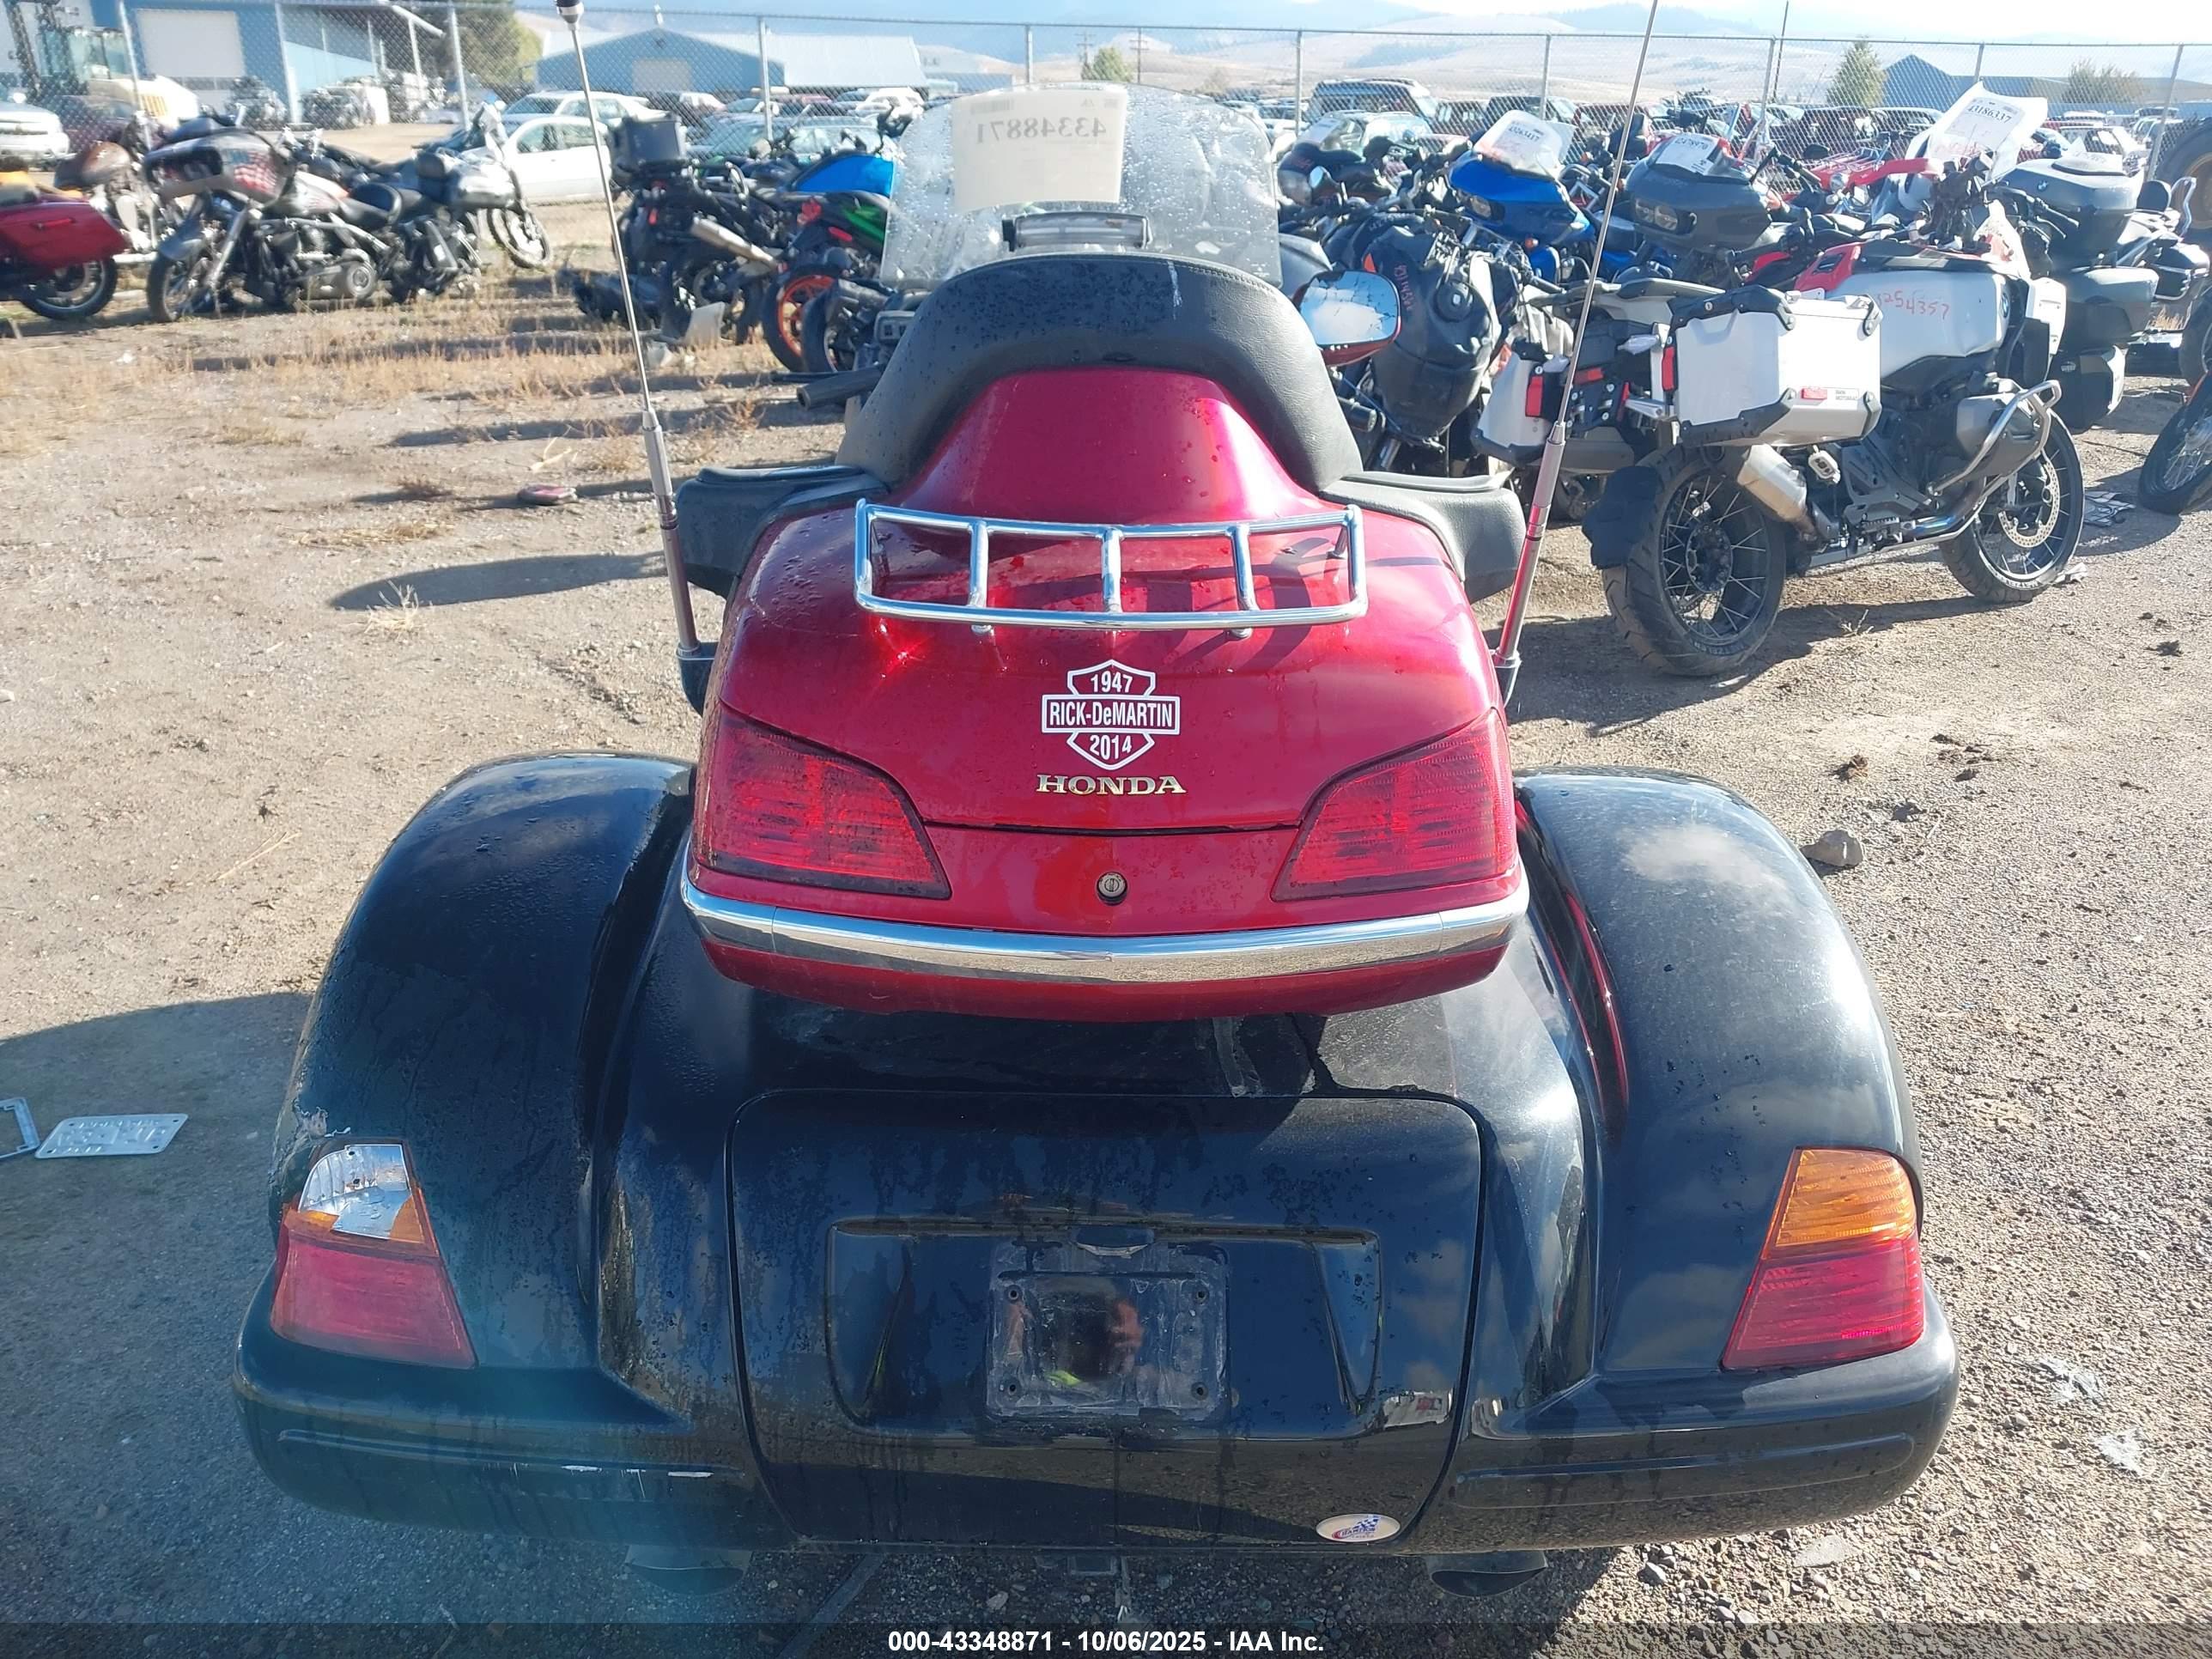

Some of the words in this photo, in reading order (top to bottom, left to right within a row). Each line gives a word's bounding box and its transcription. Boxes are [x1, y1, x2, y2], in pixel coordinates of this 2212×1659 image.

[1091, 671, 1133, 694] 1947
[1049, 702, 1173, 727] RICK-DeMARTIN
[1089, 734, 1133, 761] 2014
[1036, 774, 1187, 795] HONDA
